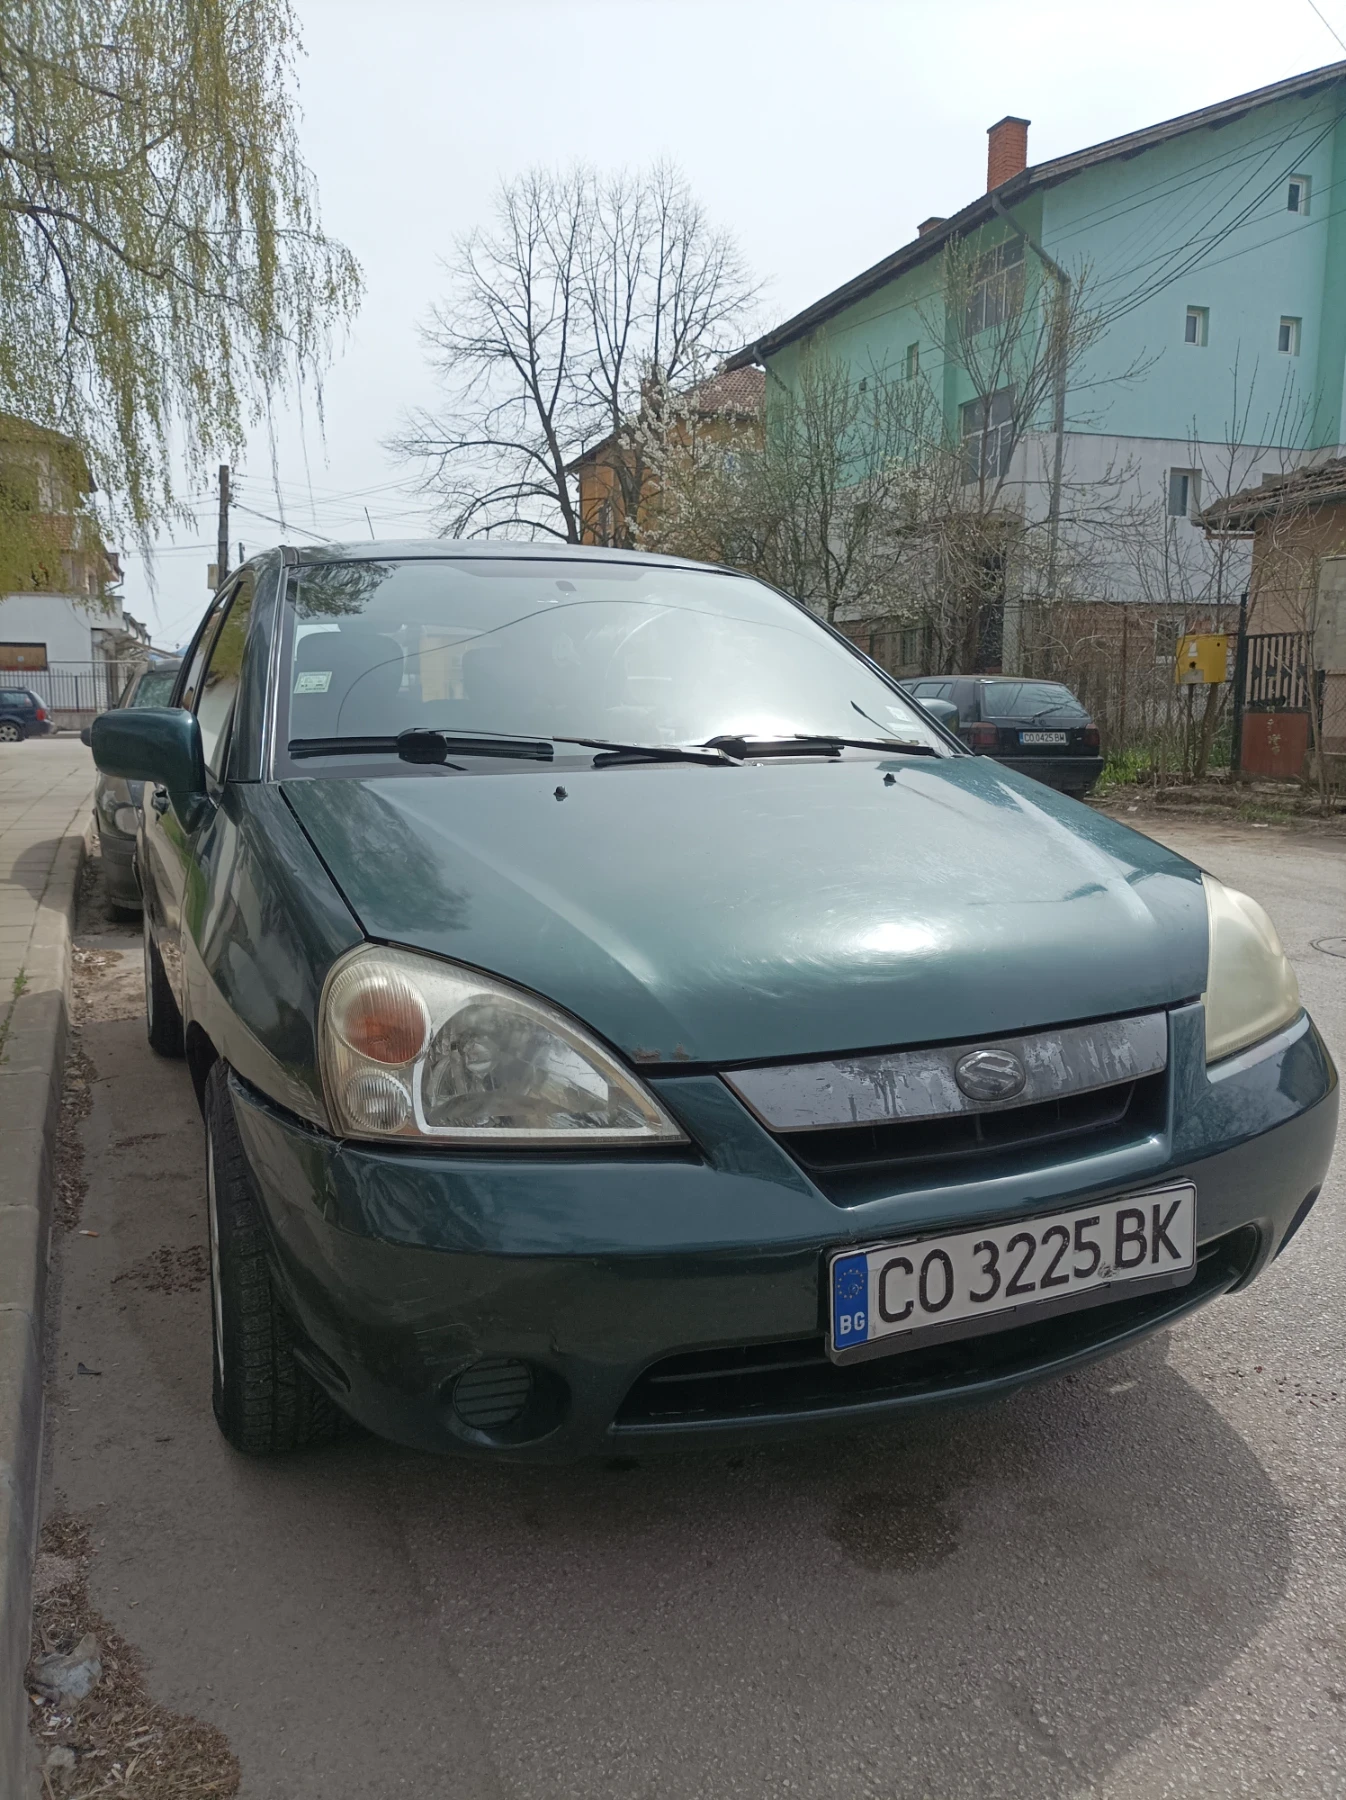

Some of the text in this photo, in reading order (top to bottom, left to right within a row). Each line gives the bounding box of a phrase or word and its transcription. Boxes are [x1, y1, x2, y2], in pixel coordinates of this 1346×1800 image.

[969, 1215, 1101, 1303] 3225
[1114, 1199, 1182, 1269] BK
[839, 1310, 866, 1335] BG
